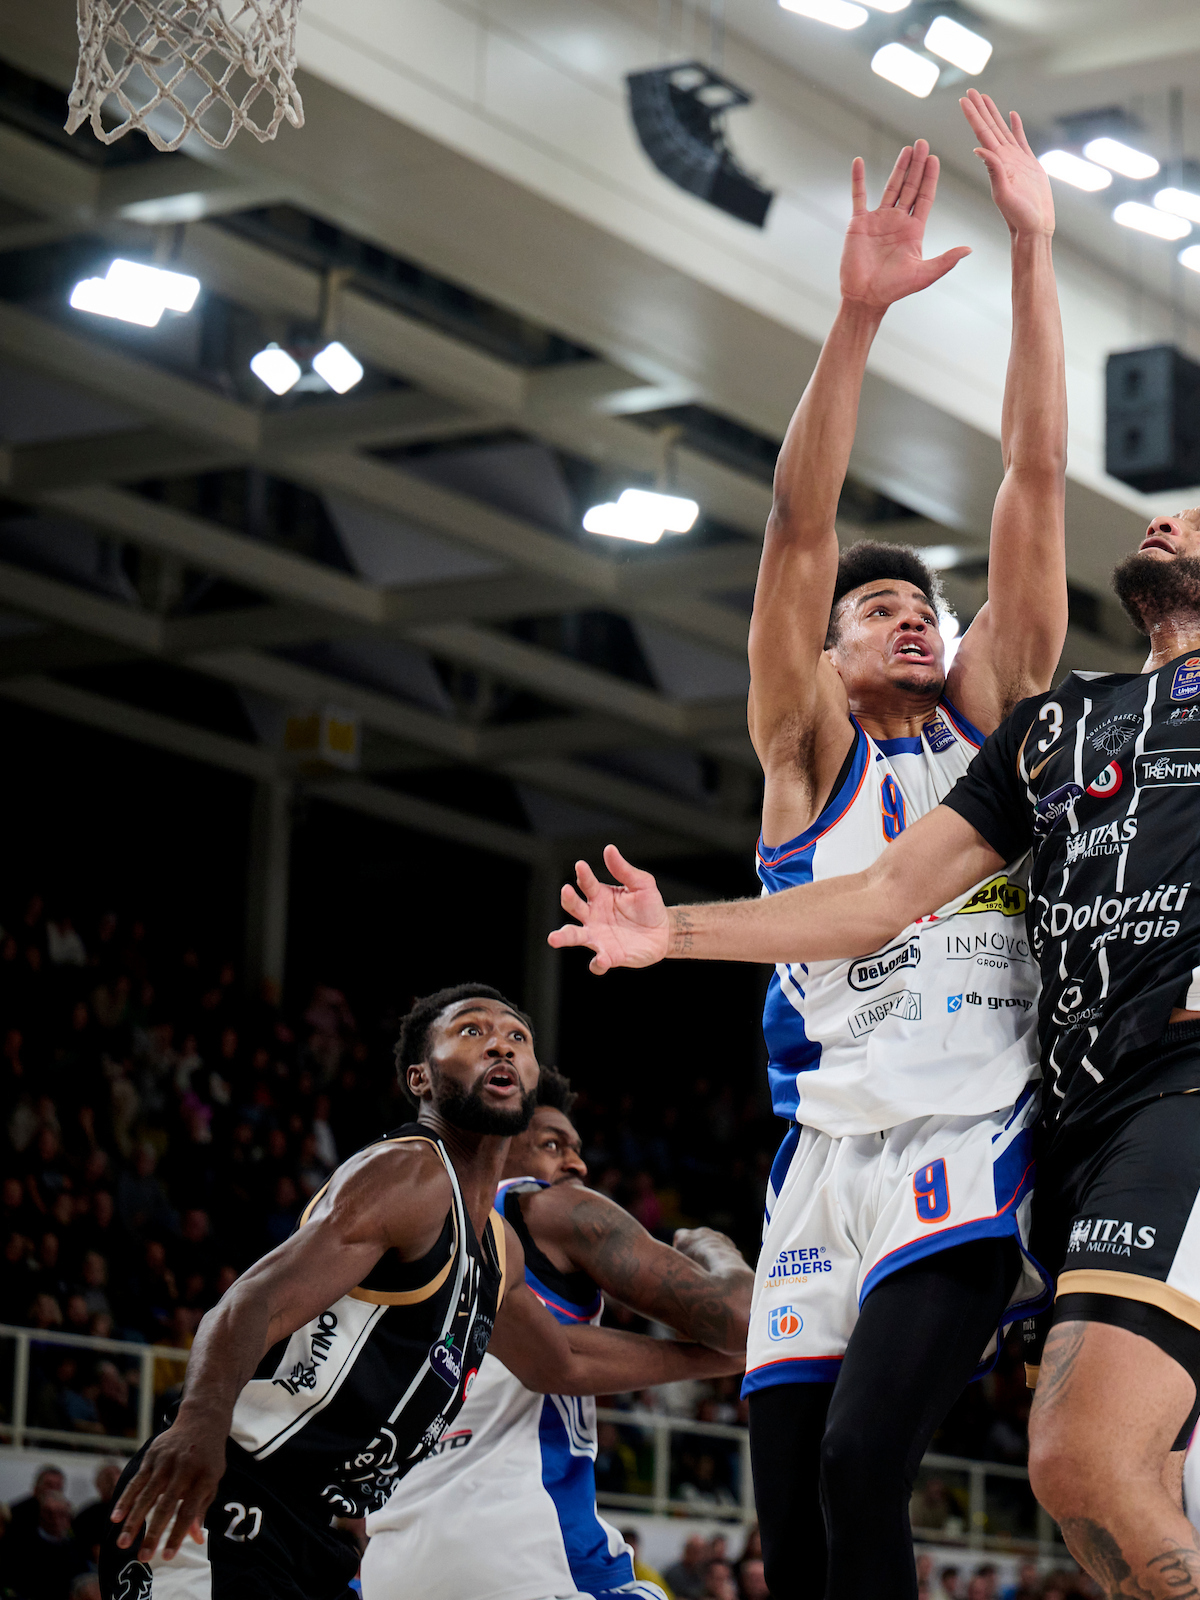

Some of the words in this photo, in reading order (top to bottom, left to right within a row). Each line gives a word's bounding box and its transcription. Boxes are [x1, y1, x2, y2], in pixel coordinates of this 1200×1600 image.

[1038, 701, 1064, 753] 3
[1086, 718, 1112, 741] AQUILA
[1113, 713, 1143, 724] BASKET
[880, 773, 907, 844] 9
[1088, 818, 1138, 849] ITAS
[1081, 843, 1121, 860] MUTUA
[976, 958, 1009, 969] GROUP
[966, 992, 982, 1006] db
[987, 996, 1033, 1013] group
[913, 1157, 951, 1225] 9
[1090, 1219, 1157, 1250] ITAS
[1085, 1241, 1131, 1257] MUTUA
[763, 1275, 808, 1289] OLUTIONS
[768, 1259, 833, 1278] UILDERS
[223, 1502, 264, 1543] 21
